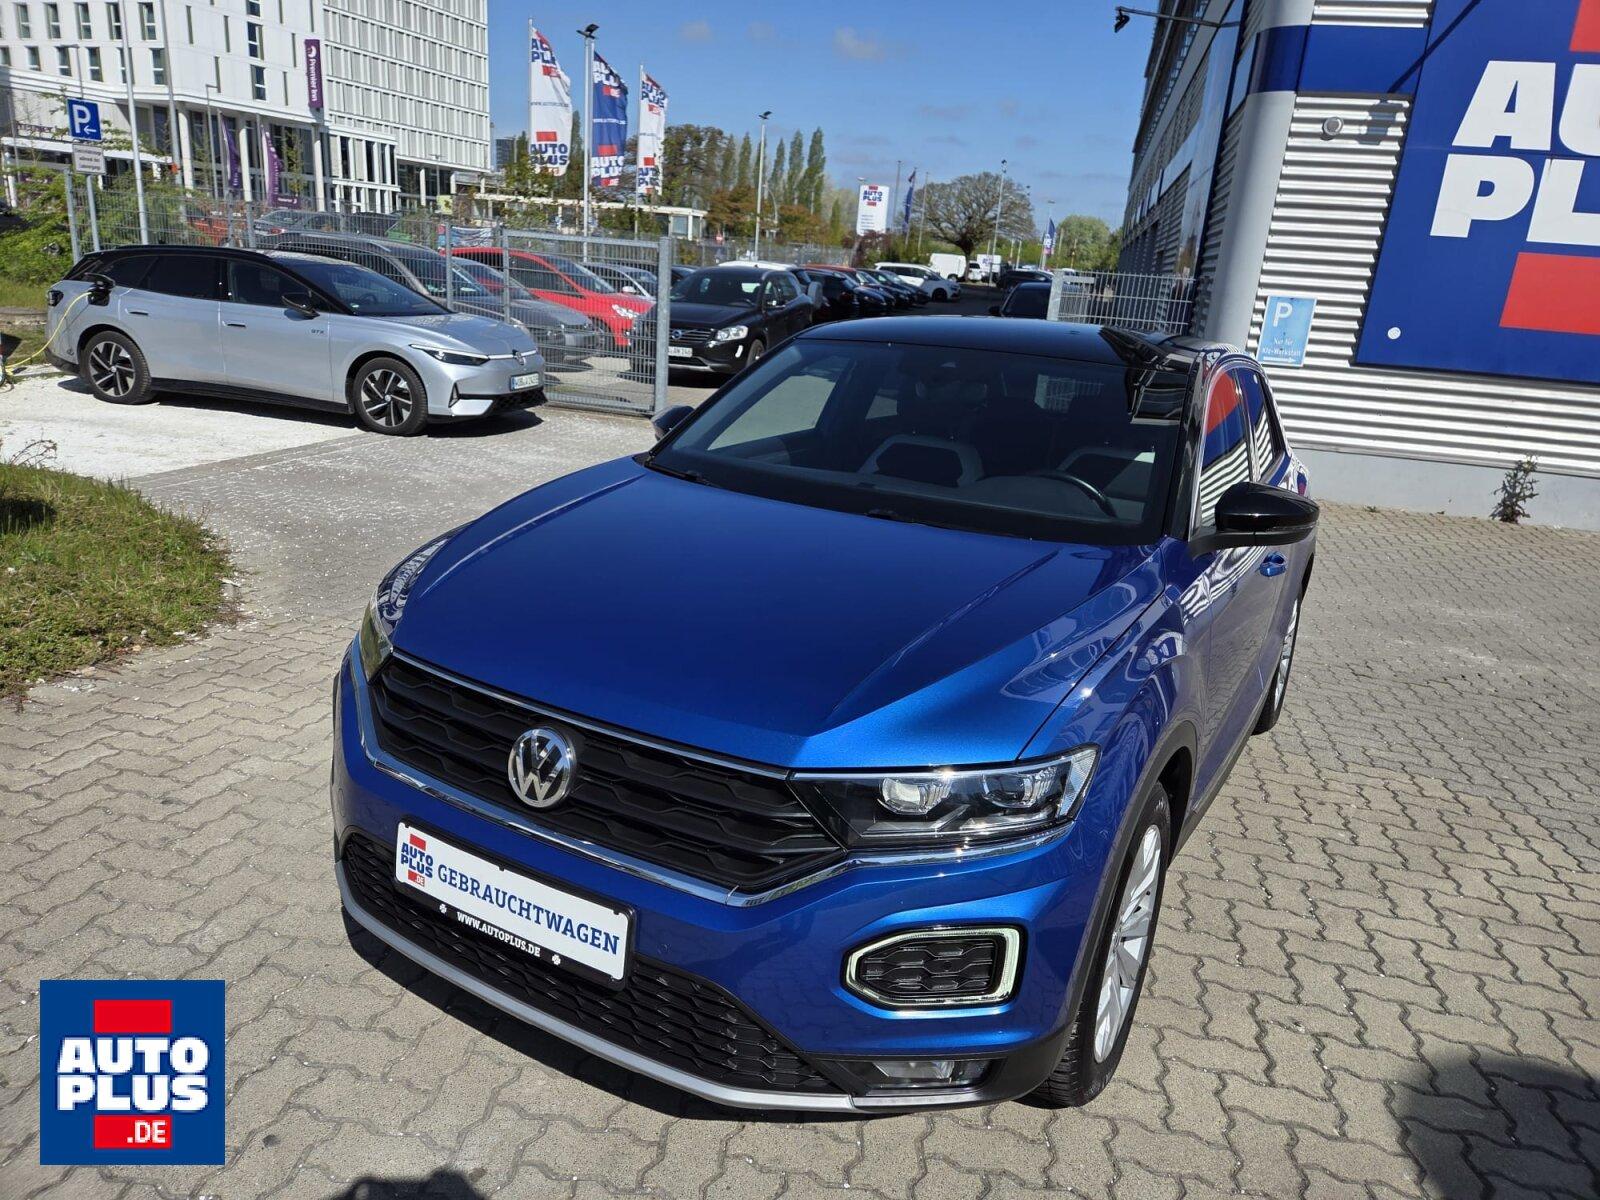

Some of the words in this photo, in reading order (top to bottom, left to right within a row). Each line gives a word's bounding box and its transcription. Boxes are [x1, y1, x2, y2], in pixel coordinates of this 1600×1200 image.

[72, 103, 91, 134] P
[530, 143, 569, 155] AUTO
[1272, 301, 1293, 328] P
[400, 853, 434, 879] PLUS
[401, 842, 434, 867] AUTO
[437, 864, 620, 956] GEBRAUCHTWAGEN
[456, 911, 542, 958] WWW.AUTOPLUS.DE
